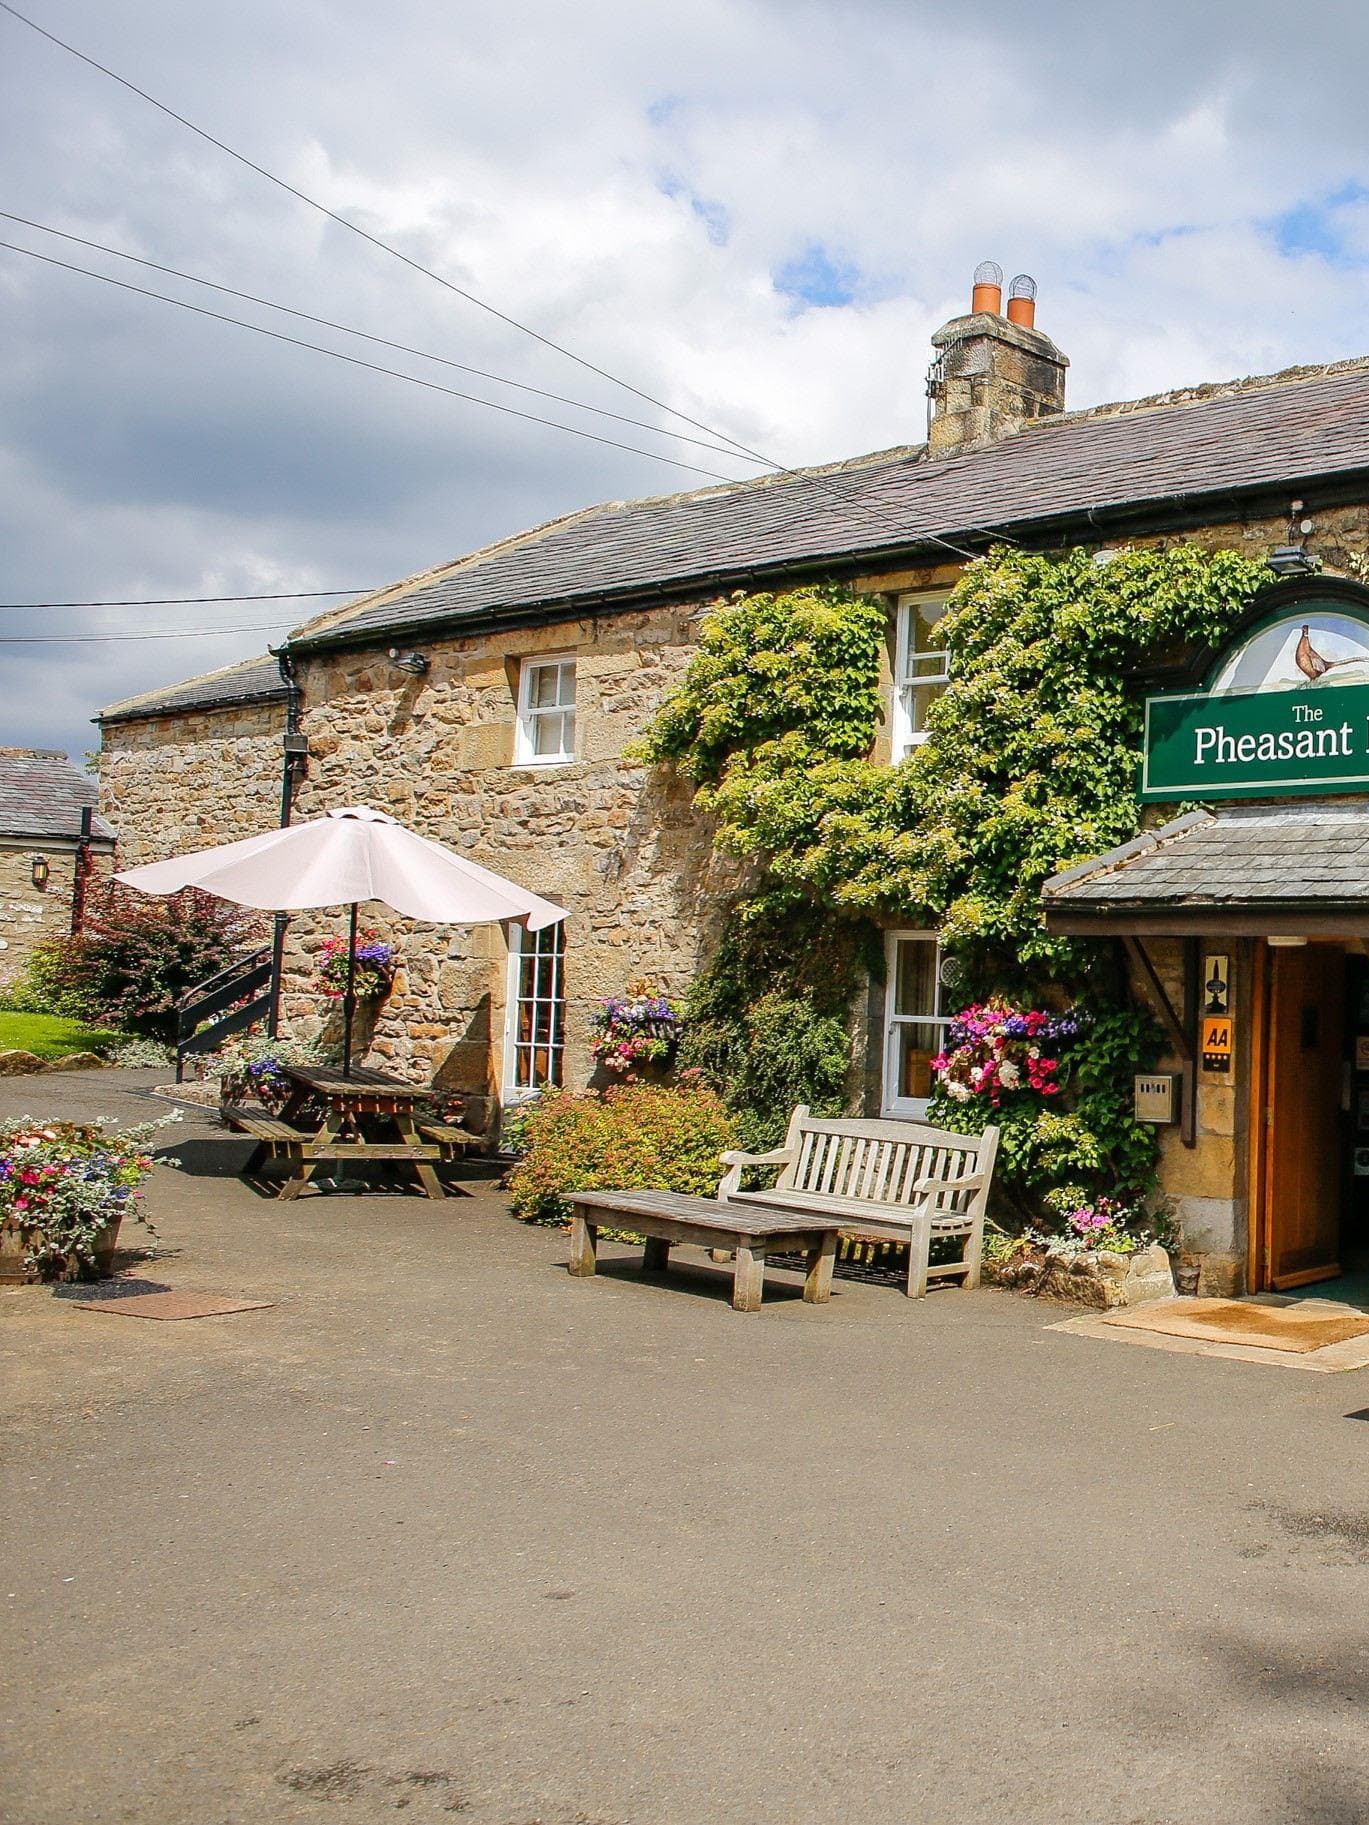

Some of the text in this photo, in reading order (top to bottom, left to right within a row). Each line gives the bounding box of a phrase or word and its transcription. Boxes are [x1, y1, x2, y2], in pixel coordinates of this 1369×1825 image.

[1292, 705, 1323, 722] The
[1194, 722, 1353, 764] Pheasant
[1207, 1028, 1228, 1046] AA
